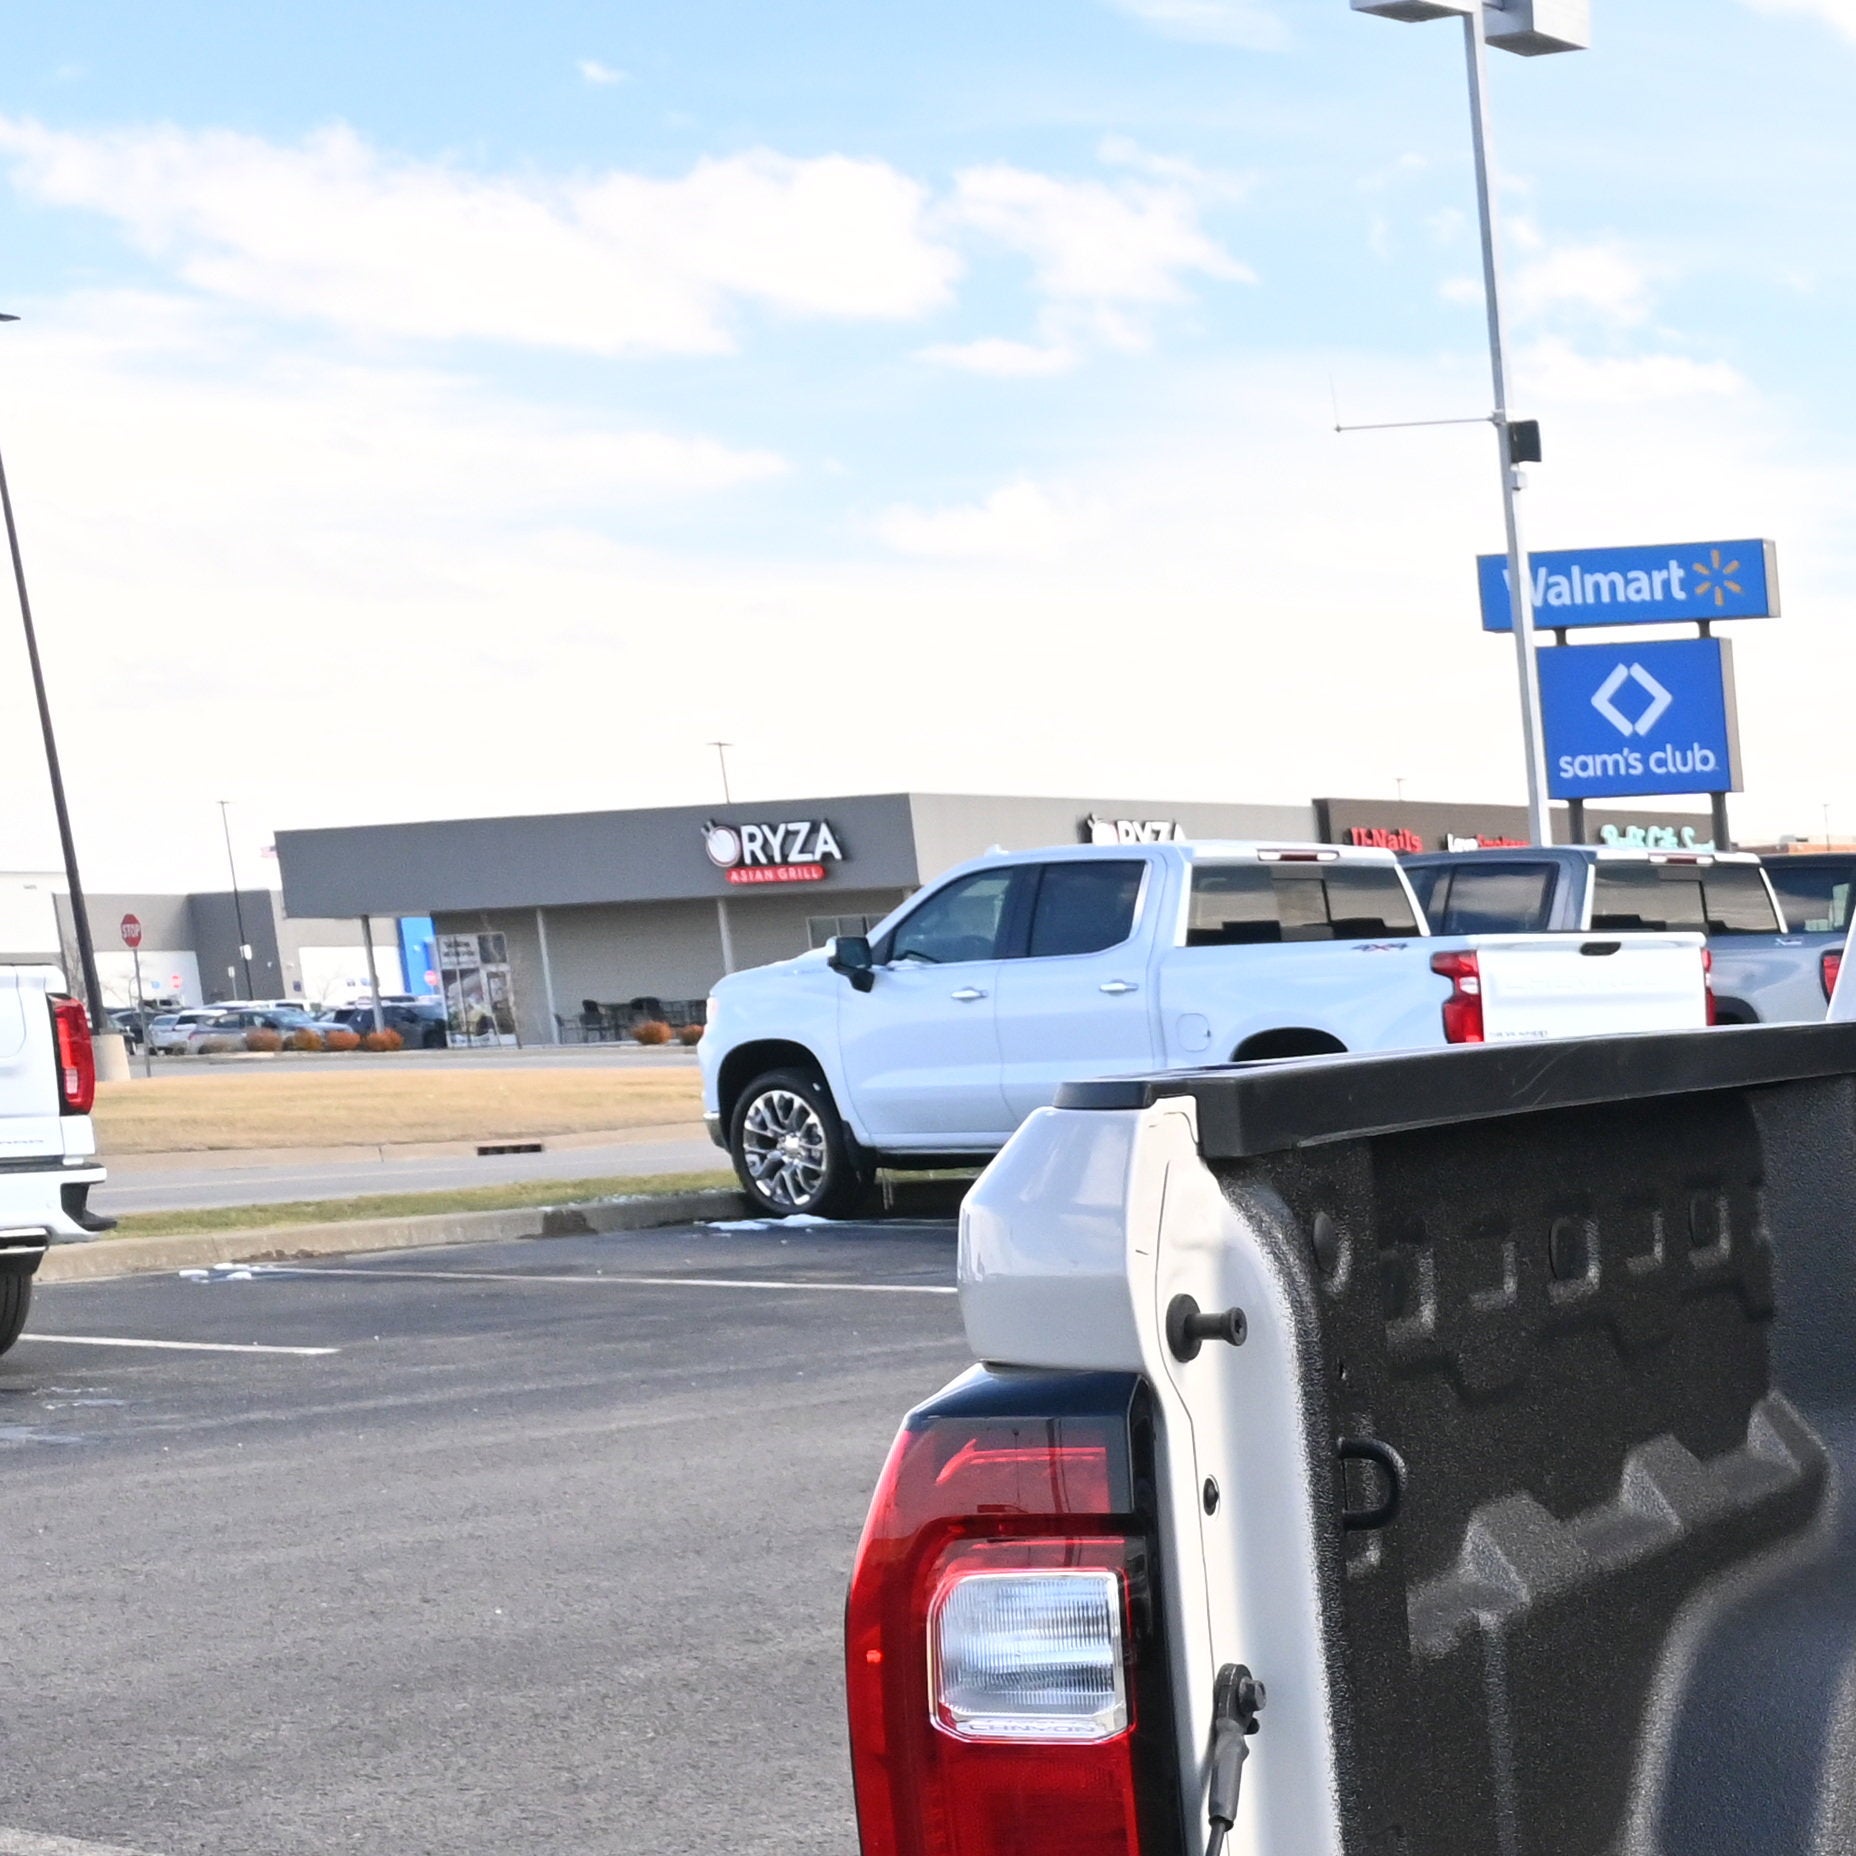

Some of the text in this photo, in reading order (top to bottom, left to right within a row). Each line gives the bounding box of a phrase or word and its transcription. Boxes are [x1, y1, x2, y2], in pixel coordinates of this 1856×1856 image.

[1558, 742, 1718, 779] sam's club
[730, 867, 819, 883] ASIAN GRILL
[121, 923, 141, 939] STOP
